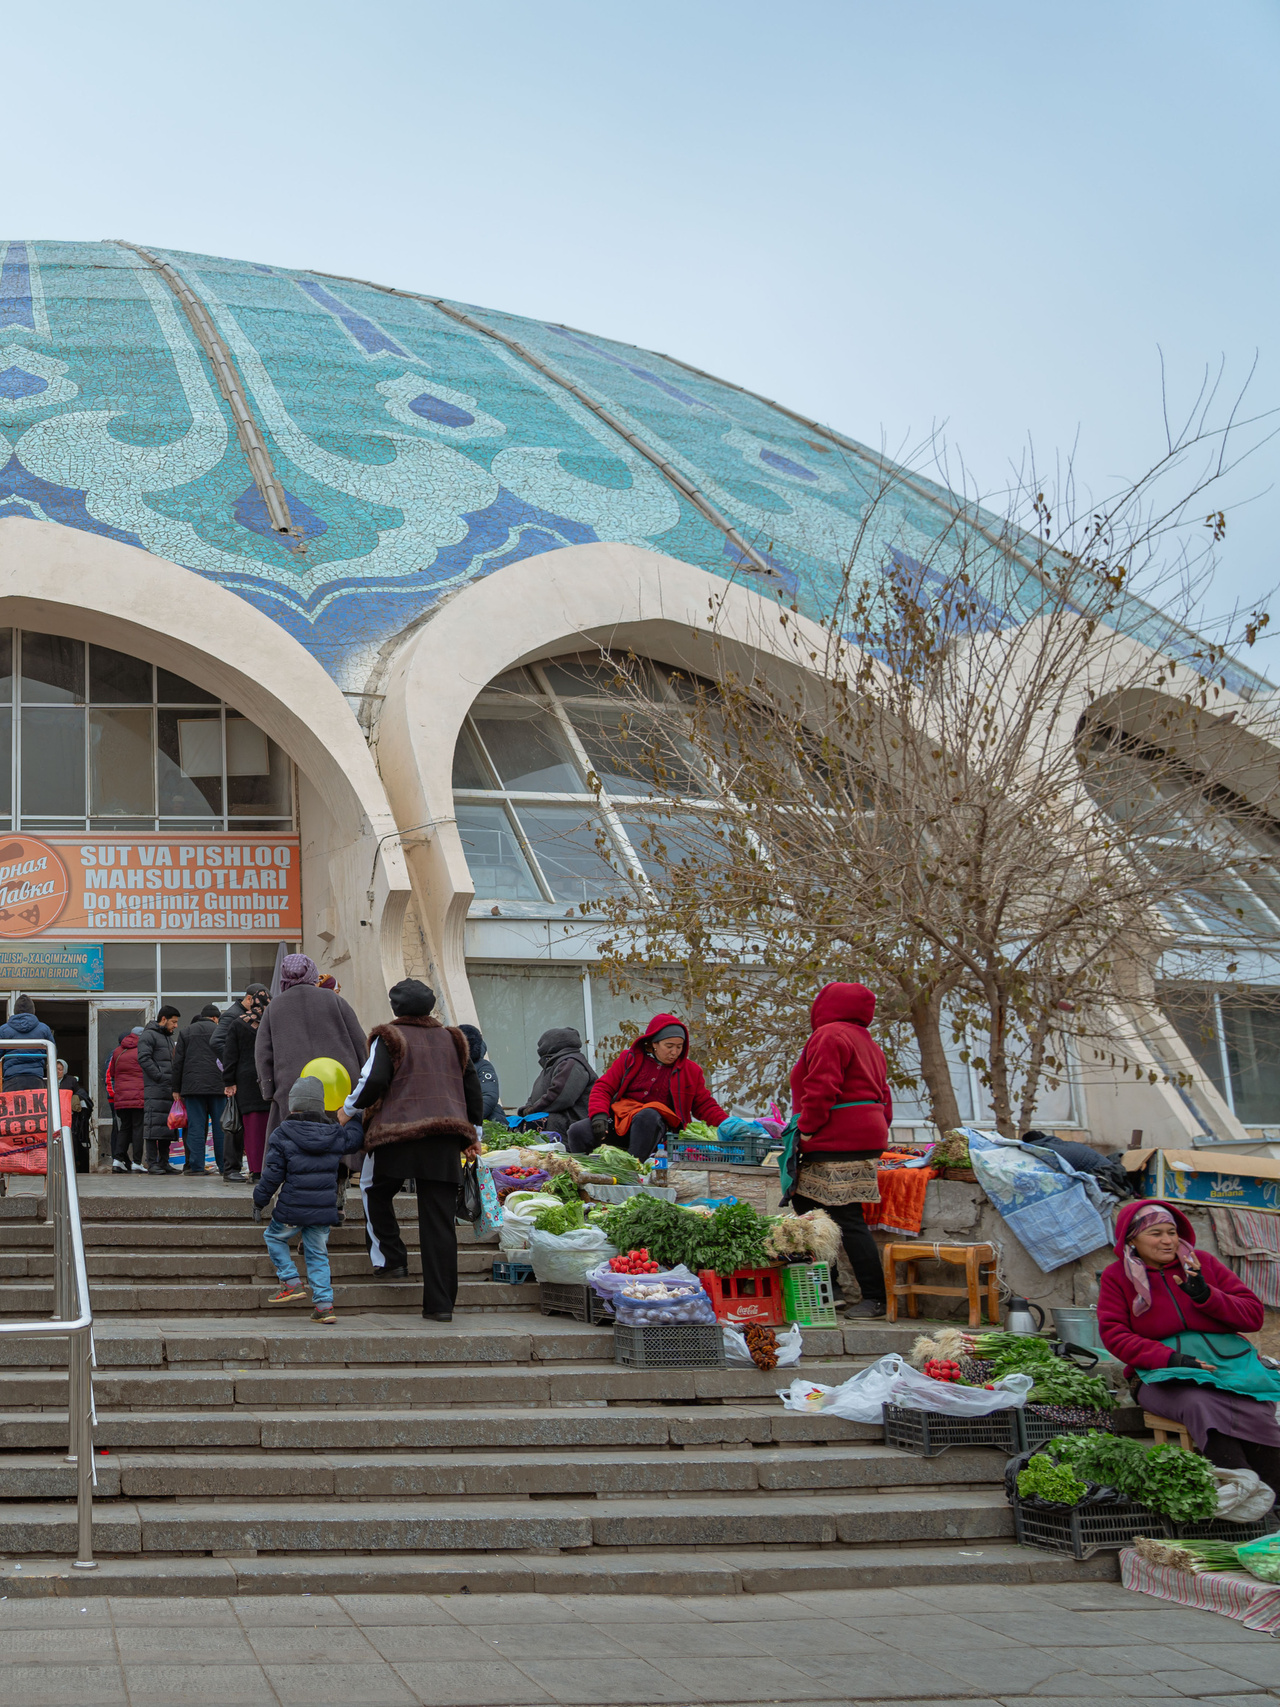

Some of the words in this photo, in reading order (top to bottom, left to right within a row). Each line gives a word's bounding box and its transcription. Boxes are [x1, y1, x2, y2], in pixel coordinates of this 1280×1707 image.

[80, 846, 131, 866] SUT
[137, 846, 173, 866] VA
[179, 846, 291, 869] PISHLOQ
[85, 869, 287, 889] MAHSULOTLARI
[83, 892, 111, 910] Do
[116, 892, 199, 910] konimiz
[204, 892, 289, 910] Gumbuz
[87, 910, 155, 928] ichida
[160, 910, 280, 930] joylashgan
[29, 953, 88, 965] XALQIMIZNING
[47, 968, 79, 978] BIRIDIR
[0, 1116, 48, 1135] feed
[12, 1136, 35, 1146] 50
